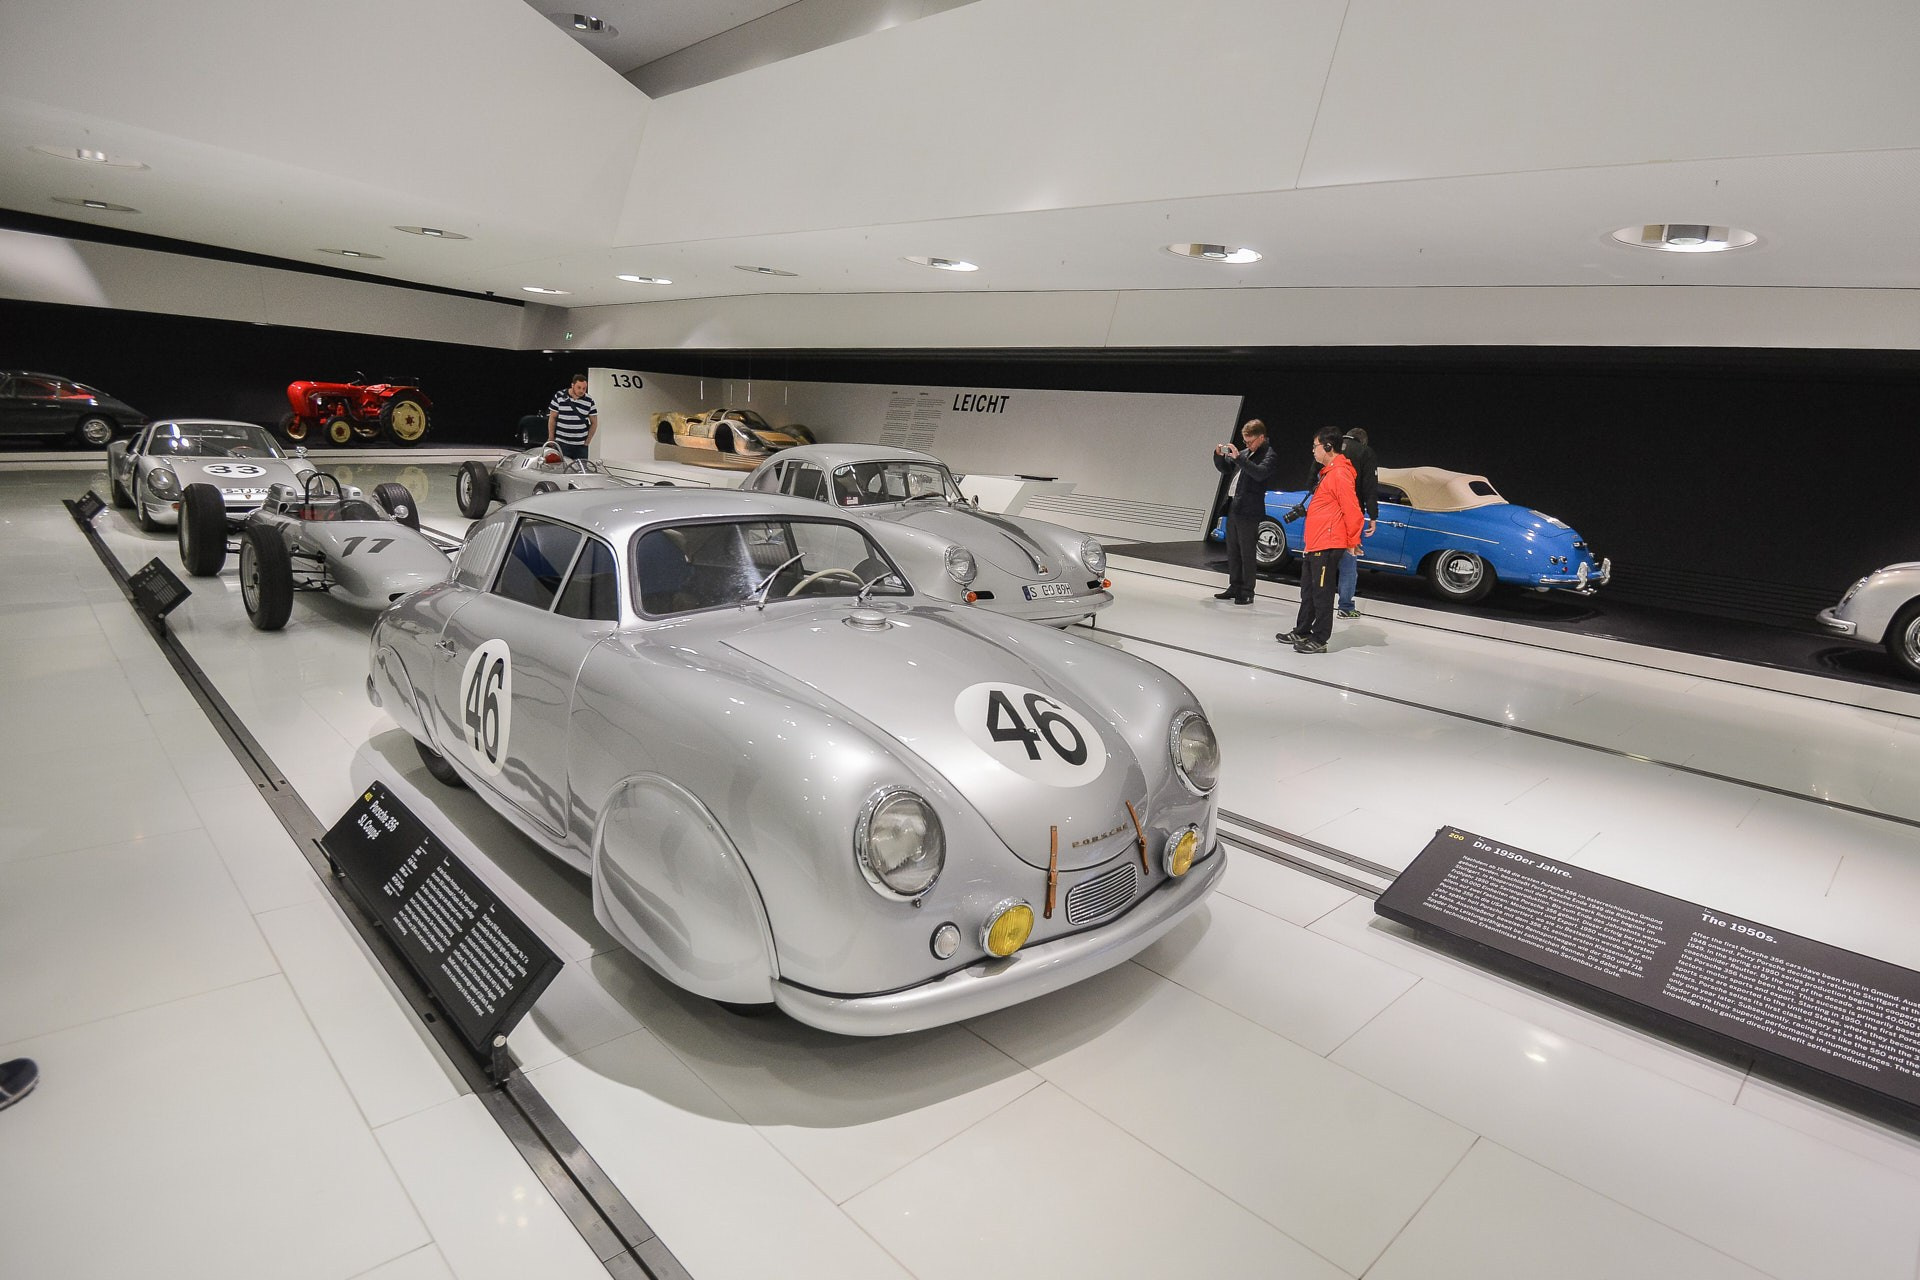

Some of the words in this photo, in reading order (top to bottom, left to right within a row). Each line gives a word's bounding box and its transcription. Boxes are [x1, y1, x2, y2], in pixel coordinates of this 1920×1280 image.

[611, 374, 643, 389] 130
[952, 394, 1010, 414] LEICHT
[208, 465, 260, 474] 33
[1030, 586, 1038, 598] S
[465, 651, 504, 764] 46
[986, 690, 1088, 766] 46
[369, 800, 389, 824] Porsche
[384, 816, 400, 832] 356
[1071, 821, 1128, 848] PORSCHE
[1448, 832, 1465, 841] 200
[1472, 840, 1492, 852] Die
[1493, 847, 1535, 866] 1950er
[1536, 862, 1573, 879] Jahre.
[1692, 931, 1710, 940] After
[1723, 941, 1738, 949] first
[1739, 946, 1768, 959] Porsche
[1769, 956, 1784, 964] 356
[1802, 966, 1820, 975] have
[1821, 972, 1840, 982] been
[1841, 979, 1859, 988] built
[1701, 913, 1727, 928] The
[1729, 922, 1778, 944] 1950s.
[1674, 965, 1697, 976] sports
[1698, 974, 1714, 982] cars
[1728, 984, 1762, 998] exported
[1772, 998, 1785, 1006] the
[1787, 1003, 1813, 1016] United
[1843, 1023, 1868, 1035] where
[1869, 1031, 1888, 1042] they
[1678, 959, 1704, 972] factors:
[1705, 969, 1728, 979] motor
[1729, 977, 1753, 988] sports
[1769, 991, 1796, 1003] export.
[1797, 1000, 1830, 1015] Starting
[1864, 1022, 1877, 1030] the
[1879, 1027, 1896, 1037] first
[1683, 948, 1729, 966] coachbuilder
[1729, 963, 1758, 976] Reutter.
[1784, 982, 1799, 990] end
[1855, 1006, 1883, 1018] almost
[1884, 1015, 1915, 1028] 40,000
[1686, 942, 1704, 952] 1949.
[1728, 956, 1751, 967] spring
[1761, 966, 1779, 976] 1950
[1780, 973, 1803, 984] series
[1804, 981, 1847, 998] production
[1847, 995, 1874, 1007] begins
[1689, 936, 1706, 945] 1948
[1736, 951, 1755, 961] Ferry
[1756, 958, 1785, 971] Porsche
[1786, 969, 1815, 981] decides
[1826, 982, 1851, 992] return
[1862, 992, 1899, 1008] Stuttgart
[1693, 957, 1722, 970] Porsche
[1723, 967, 1737, 976] 356
[1738, 972, 1756, 982] have
[1757, 979, 1775, 989] been
[1777, 985, 1796, 996] built.
[1798, 992, 1814, 1002] This
[1815, 999, 1846, 1013] success
[1856, 1013, 1893, 1029] primarily
[1662, 989, 1700, 1006] knowledge
[1701, 1003, 1718, 1013] thus
[1718, 1010, 1745, 1022] gained
[1746, 1020, 1776, 1033] directly
[1777, 1030, 1805, 1044] benefit
[1806, 1042, 1831, 1053] series
[1832, 1051, 1880, 1071] production.
[1665, 983, 1690, 995] Spyder
[1691, 993, 1712, 1003] prove
[1713, 1000, 1731, 1009] their
[1731, 1007, 1764, 1021] superior
[1764, 1019, 1814, 1040] performance
[1825, 1040, 1865, 1058] numerous
[1867, 1055, 1892, 1067] races.
[1894, 1063, 1910, 1073] The
[1668, 977, 1684, 986] only
[1685, 983, 1698, 991] one
[1699, 988, 1716, 997] year
[1717, 994, 1735, 1004] later.
[1792, 1021, 1817, 1034] racing
[1818, 1030, 1836, 1039] cars
[1837, 1036, 1852, 1045] like
[1854, 1042, 1868, 1050] the
[1869, 1047, 1886, 1057] 550
[1887, 1054, 1904, 1063] and
[1905, 1060, 1920, 1068] the
[1671, 971, 1696, 983] sellers.
[1698, 980, 1727, 994] Porsche
[1728, 991, 1751, 1002] seizes
[1764, 1003, 1780, 1012] first
[1781, 1010, 1802, 1020] class
[1803, 1017, 1831, 1030] victory
[1854, 1034, 1876, 1045] Mans
[1878, 1043, 1896, 1052] with
[1898, 1049, 1912, 1058] the
